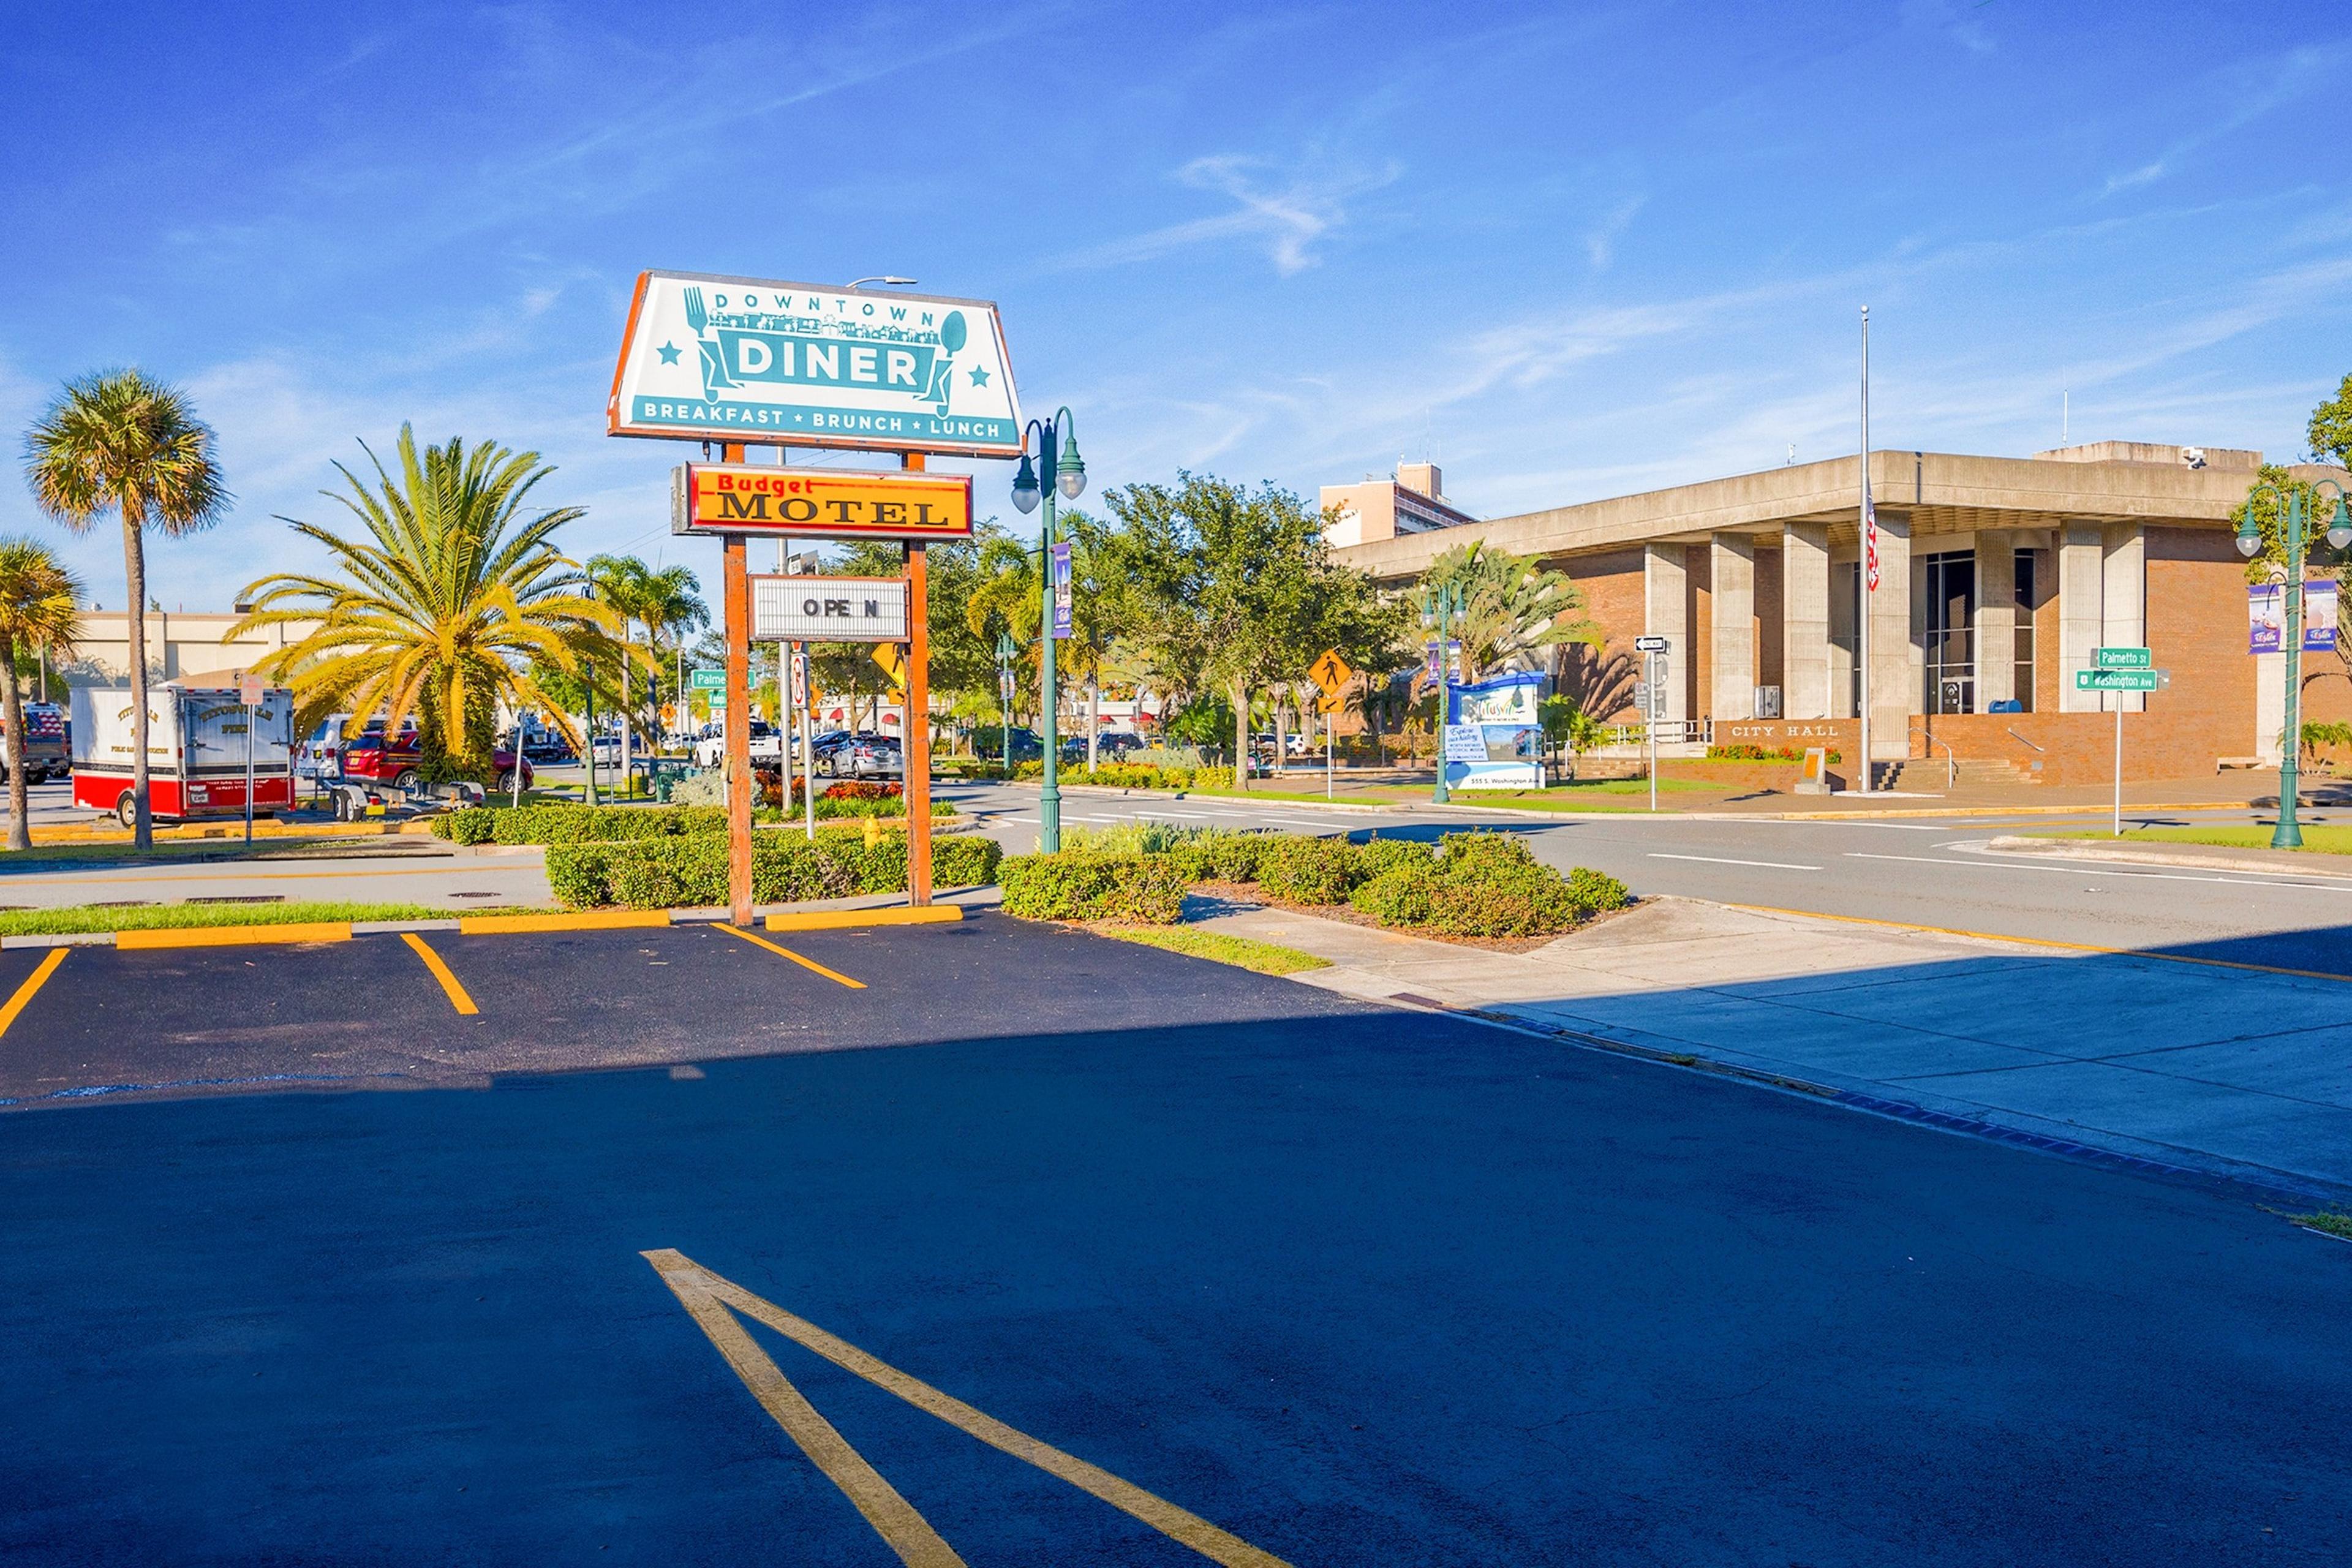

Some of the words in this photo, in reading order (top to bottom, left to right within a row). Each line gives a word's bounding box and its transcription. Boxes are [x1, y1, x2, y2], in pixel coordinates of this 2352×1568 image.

[715, 293, 934, 326] DOWNTOWN
[738, 338, 918, 386] DINER
[644, 402, 783, 424] BREAKFAST
[813, 413, 902, 432] BRUNCH
[930, 420, 1000, 437] LUNCH
[717, 474, 813, 498] Budget
[717, 492, 949, 526] MOTEL
[2101, 651, 2137, 664] Palmetto
[2094, 673, 2139, 688] Washington
[2140, 677, 2152, 687] Ave
[1732, 726, 1775, 736] CITY
[1787, 725, 1839, 736] HALL
